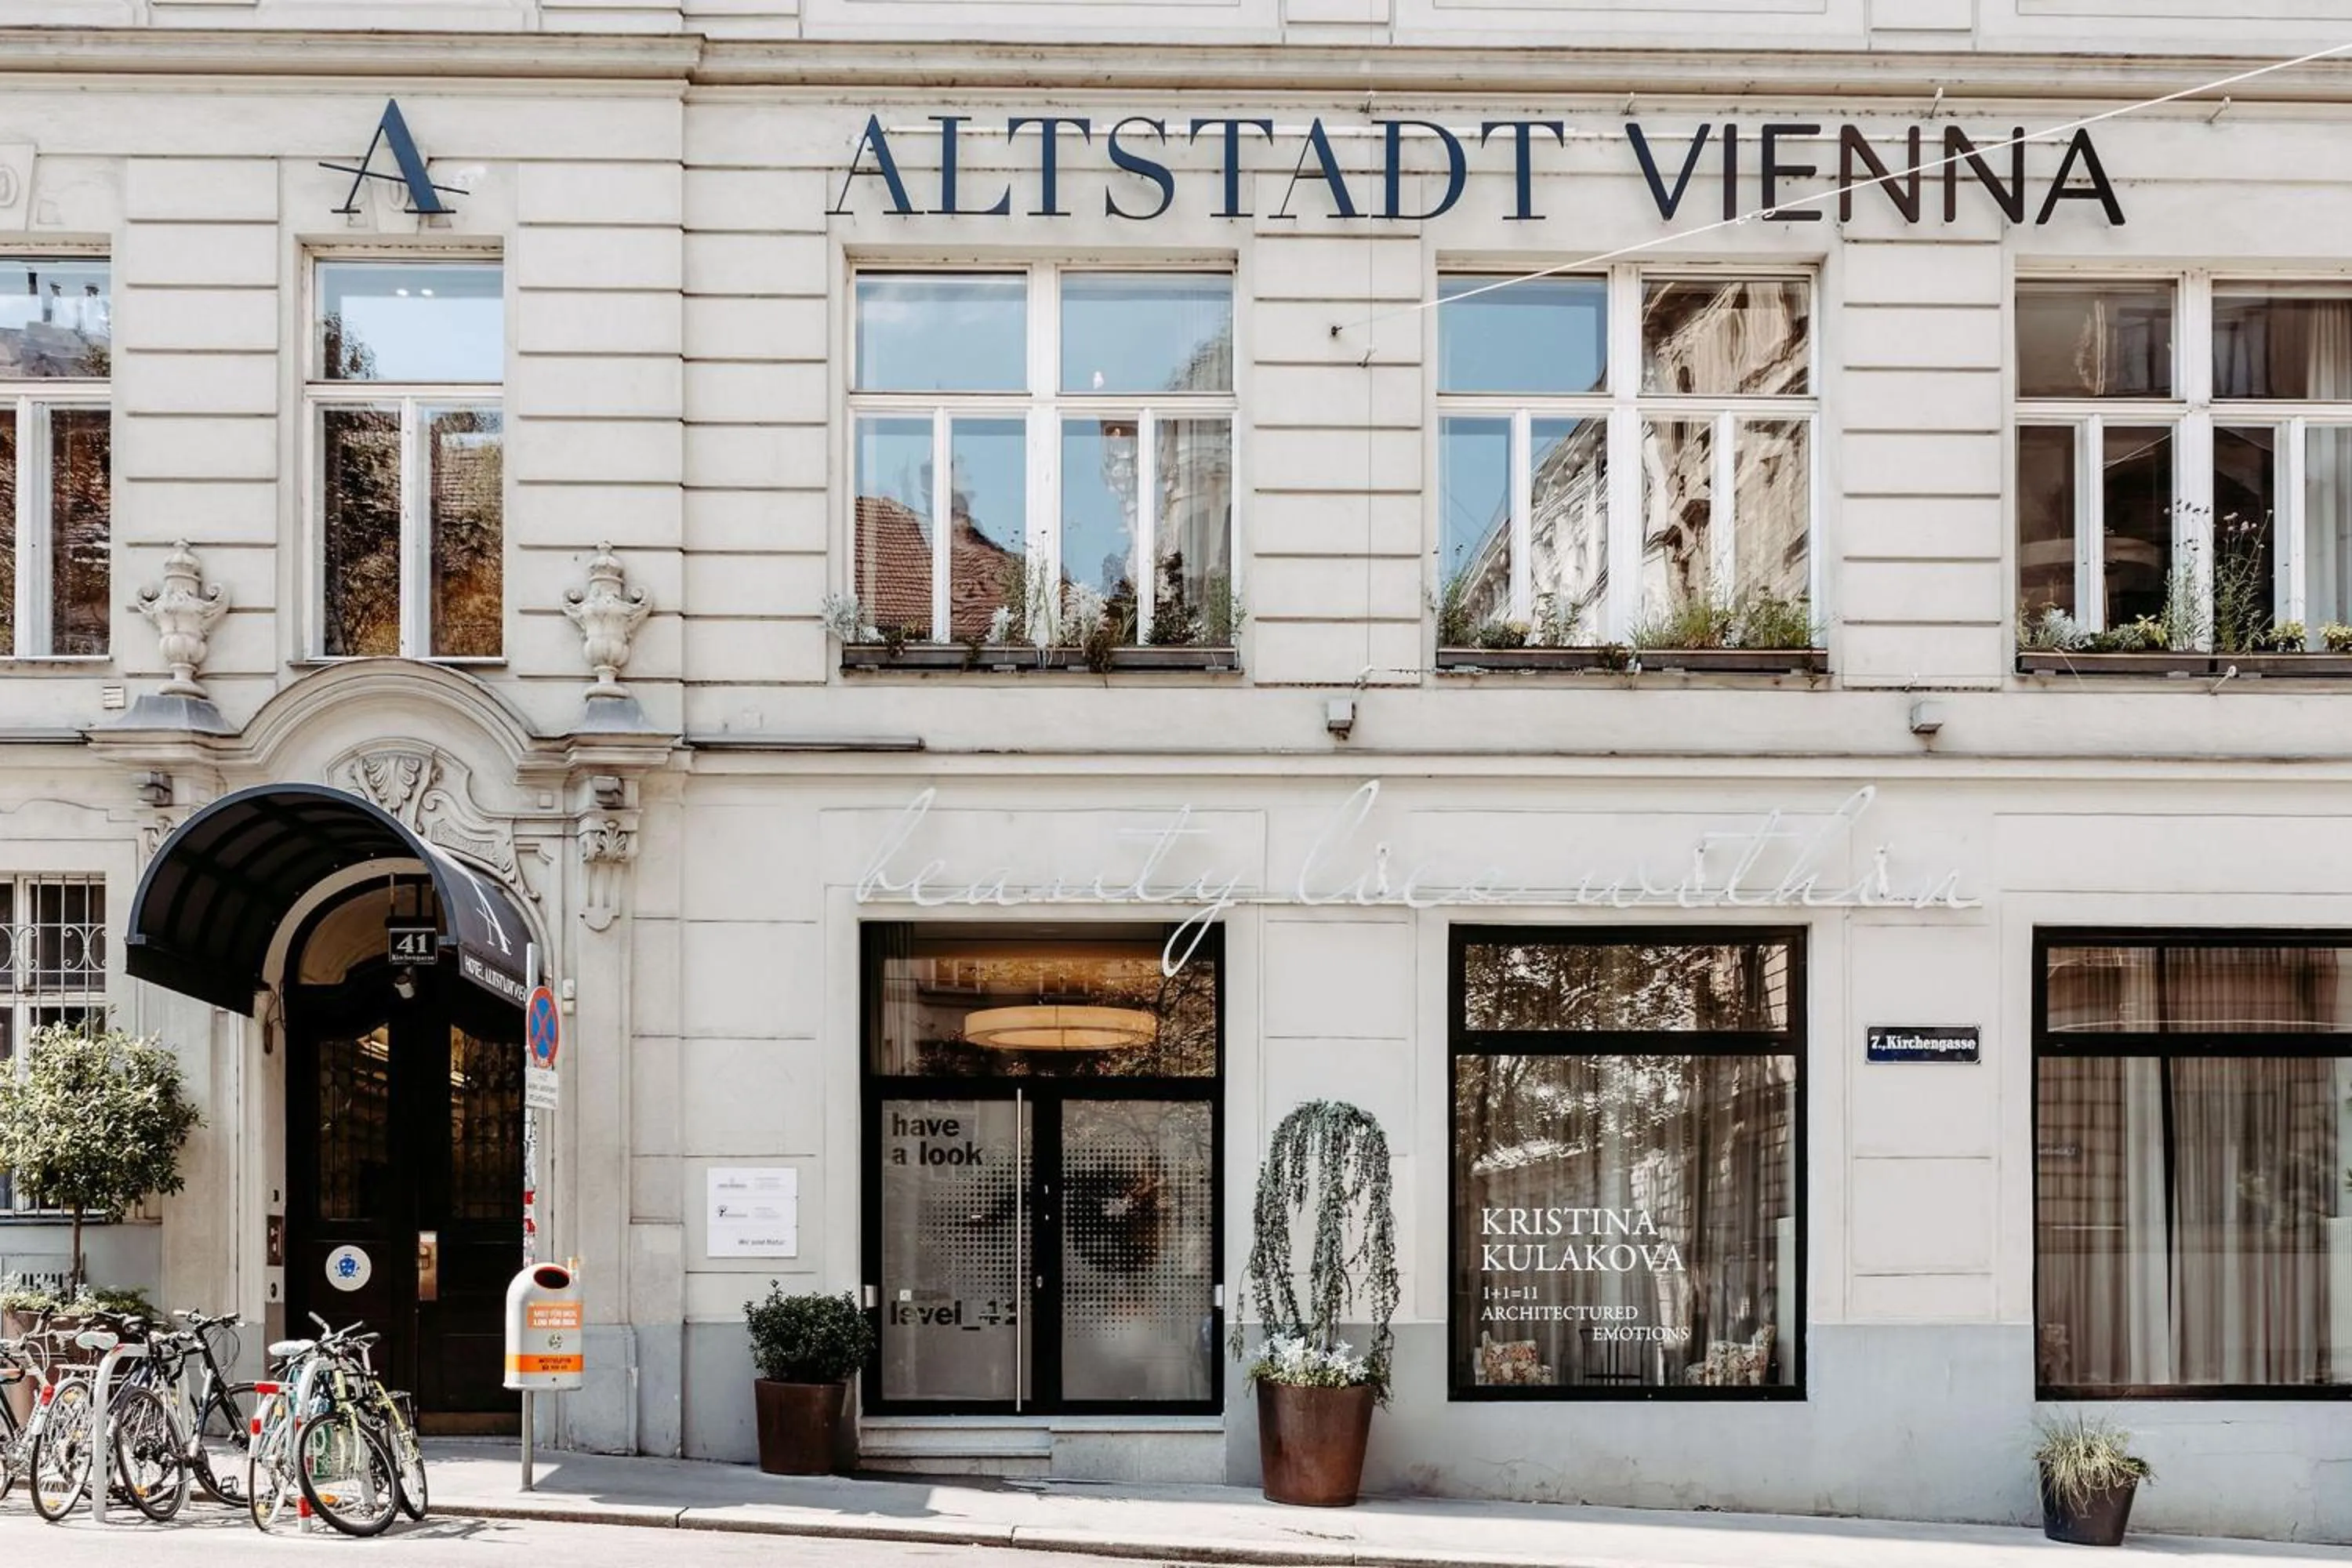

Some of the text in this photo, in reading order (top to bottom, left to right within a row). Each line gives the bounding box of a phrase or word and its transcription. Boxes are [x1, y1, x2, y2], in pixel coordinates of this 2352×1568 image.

[318, 98, 470, 214] A
[825, 114, 2126, 226] ALTSTADT VIENNA
[855, 787, 1245, 978] beauty
[1575, 784, 1981, 909] within
[397, 934, 427, 954] 41
[892, 1112, 960, 1137] have
[892, 1142, 983, 1166] a look
[1481, 1208, 1658, 1236] KRISTINA
[1481, 1244, 1686, 1272] KULAKOVA
[1483, 1287, 1538, 1300] 1+1=11
[1481, 1306, 1639, 1321] ARCHITECTURED
[1592, 1327, 1691, 1341] EMOTIONS
